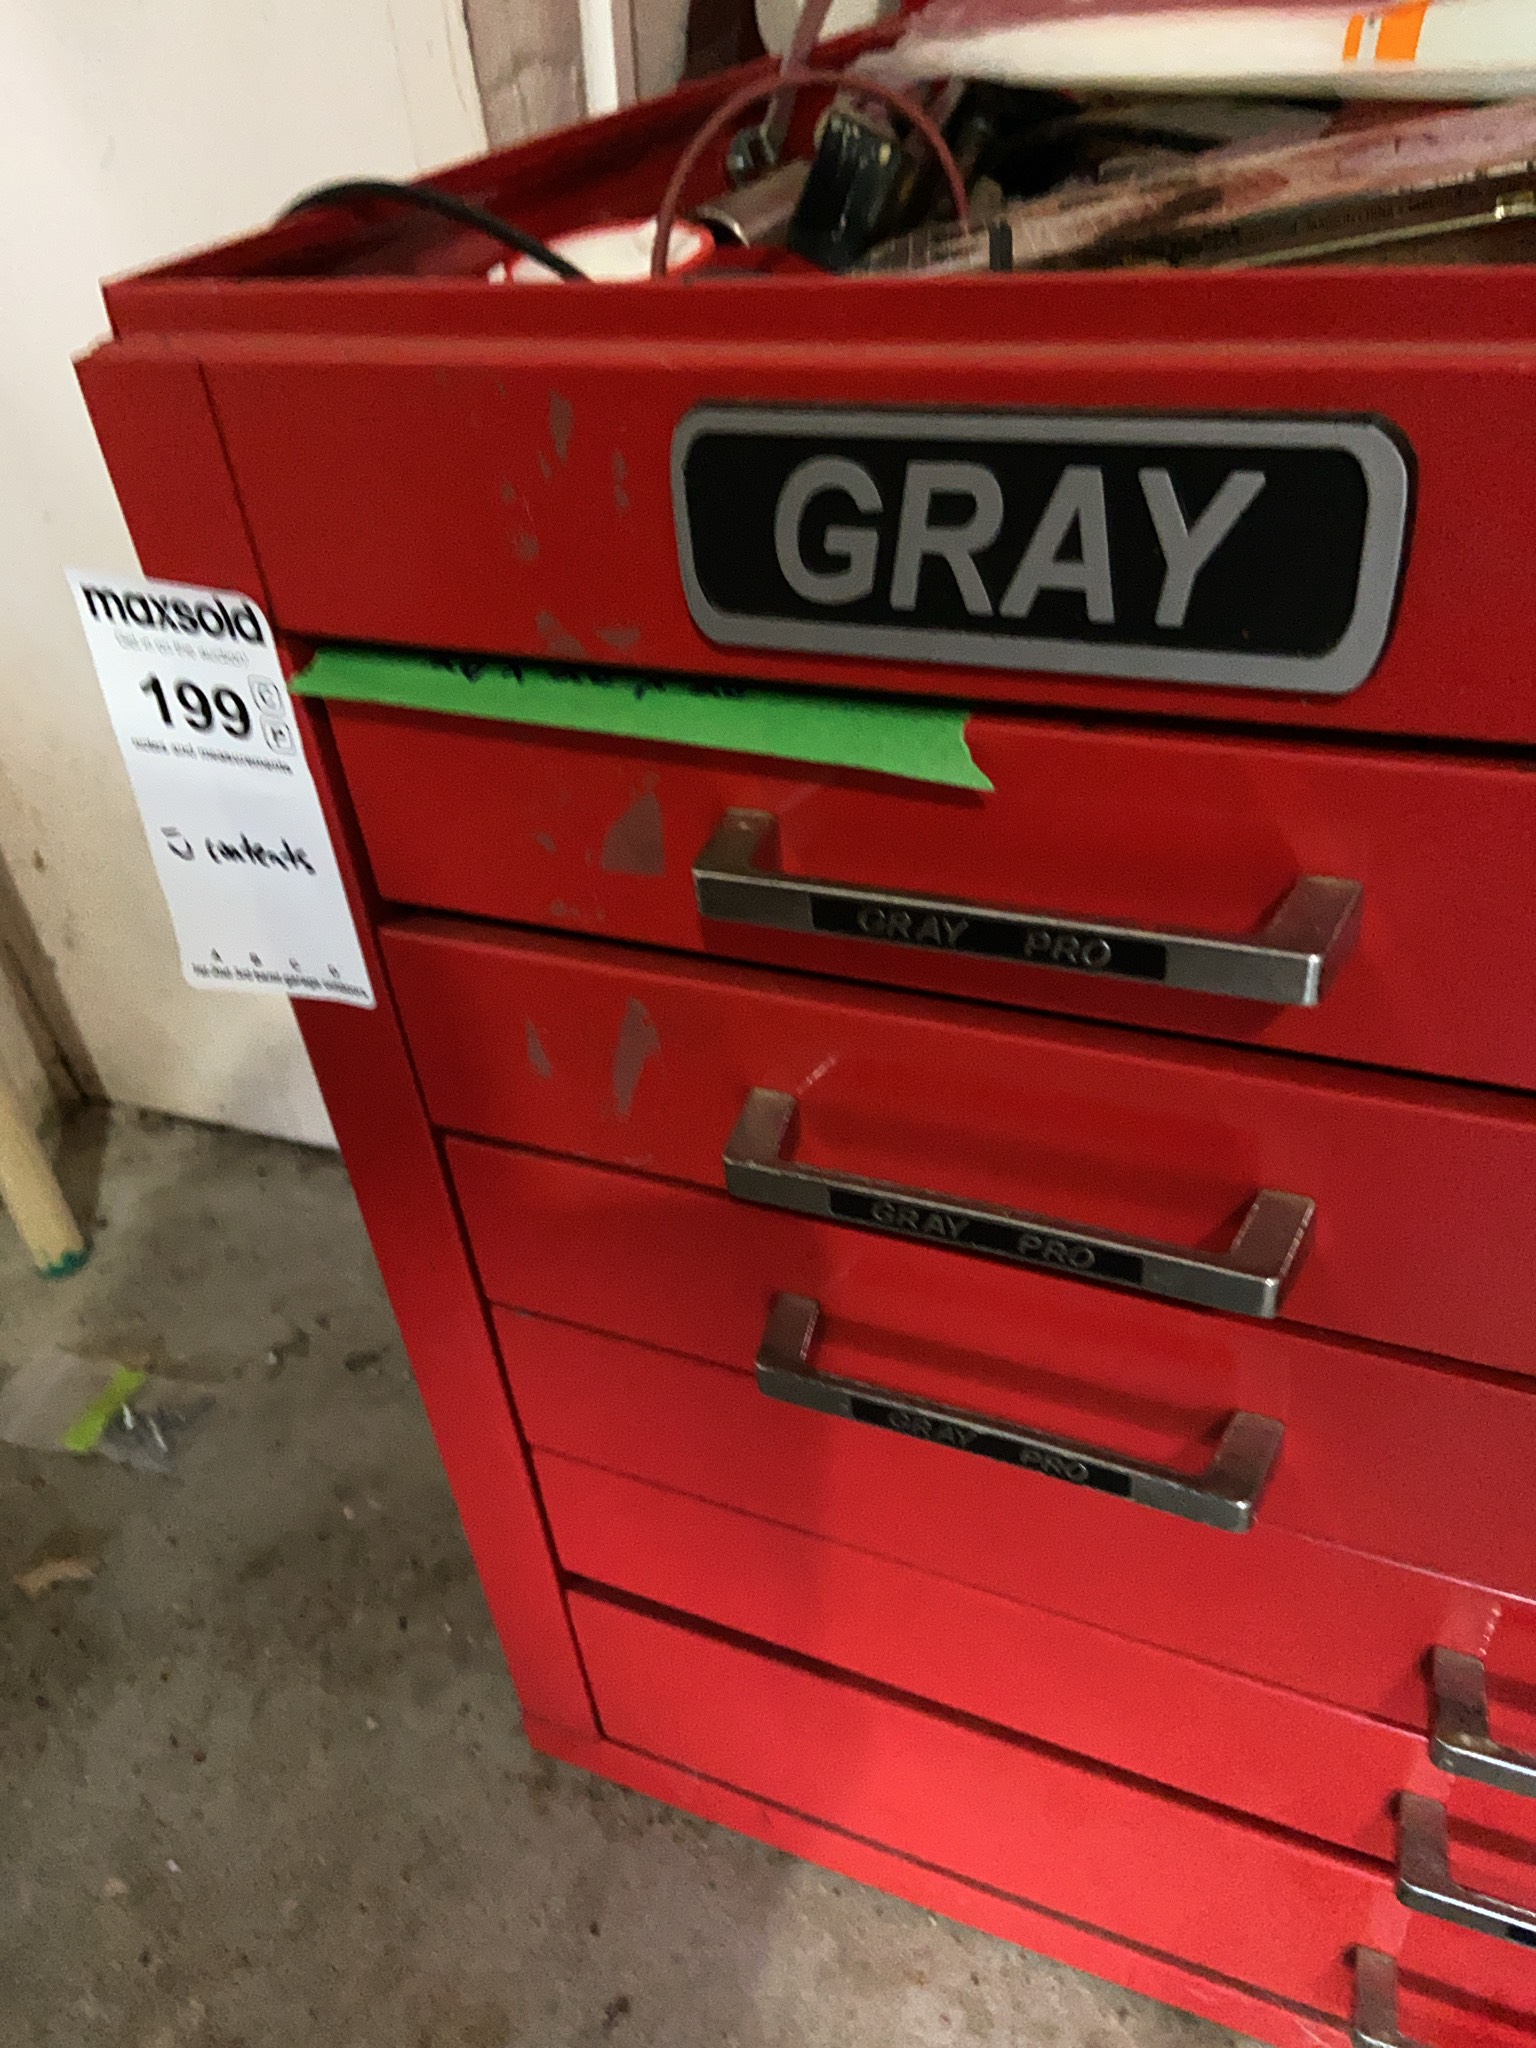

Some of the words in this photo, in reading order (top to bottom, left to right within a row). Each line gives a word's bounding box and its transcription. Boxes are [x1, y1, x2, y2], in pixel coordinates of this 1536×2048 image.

[774, 453, 1267, 629] GRAY
[80, 582, 265, 645] maxsold
[139, 671, 252, 740] 199
[856, 907, 968, 949] GRAY
[1024, 929, 1112, 968] PRO
[871, 1201, 970, 1240] GRAY
[1016, 1235, 1096, 1271] PRO
[887, 1411, 976, 1449] GRAY
[1019, 1448, 1088, 1484] PRO
